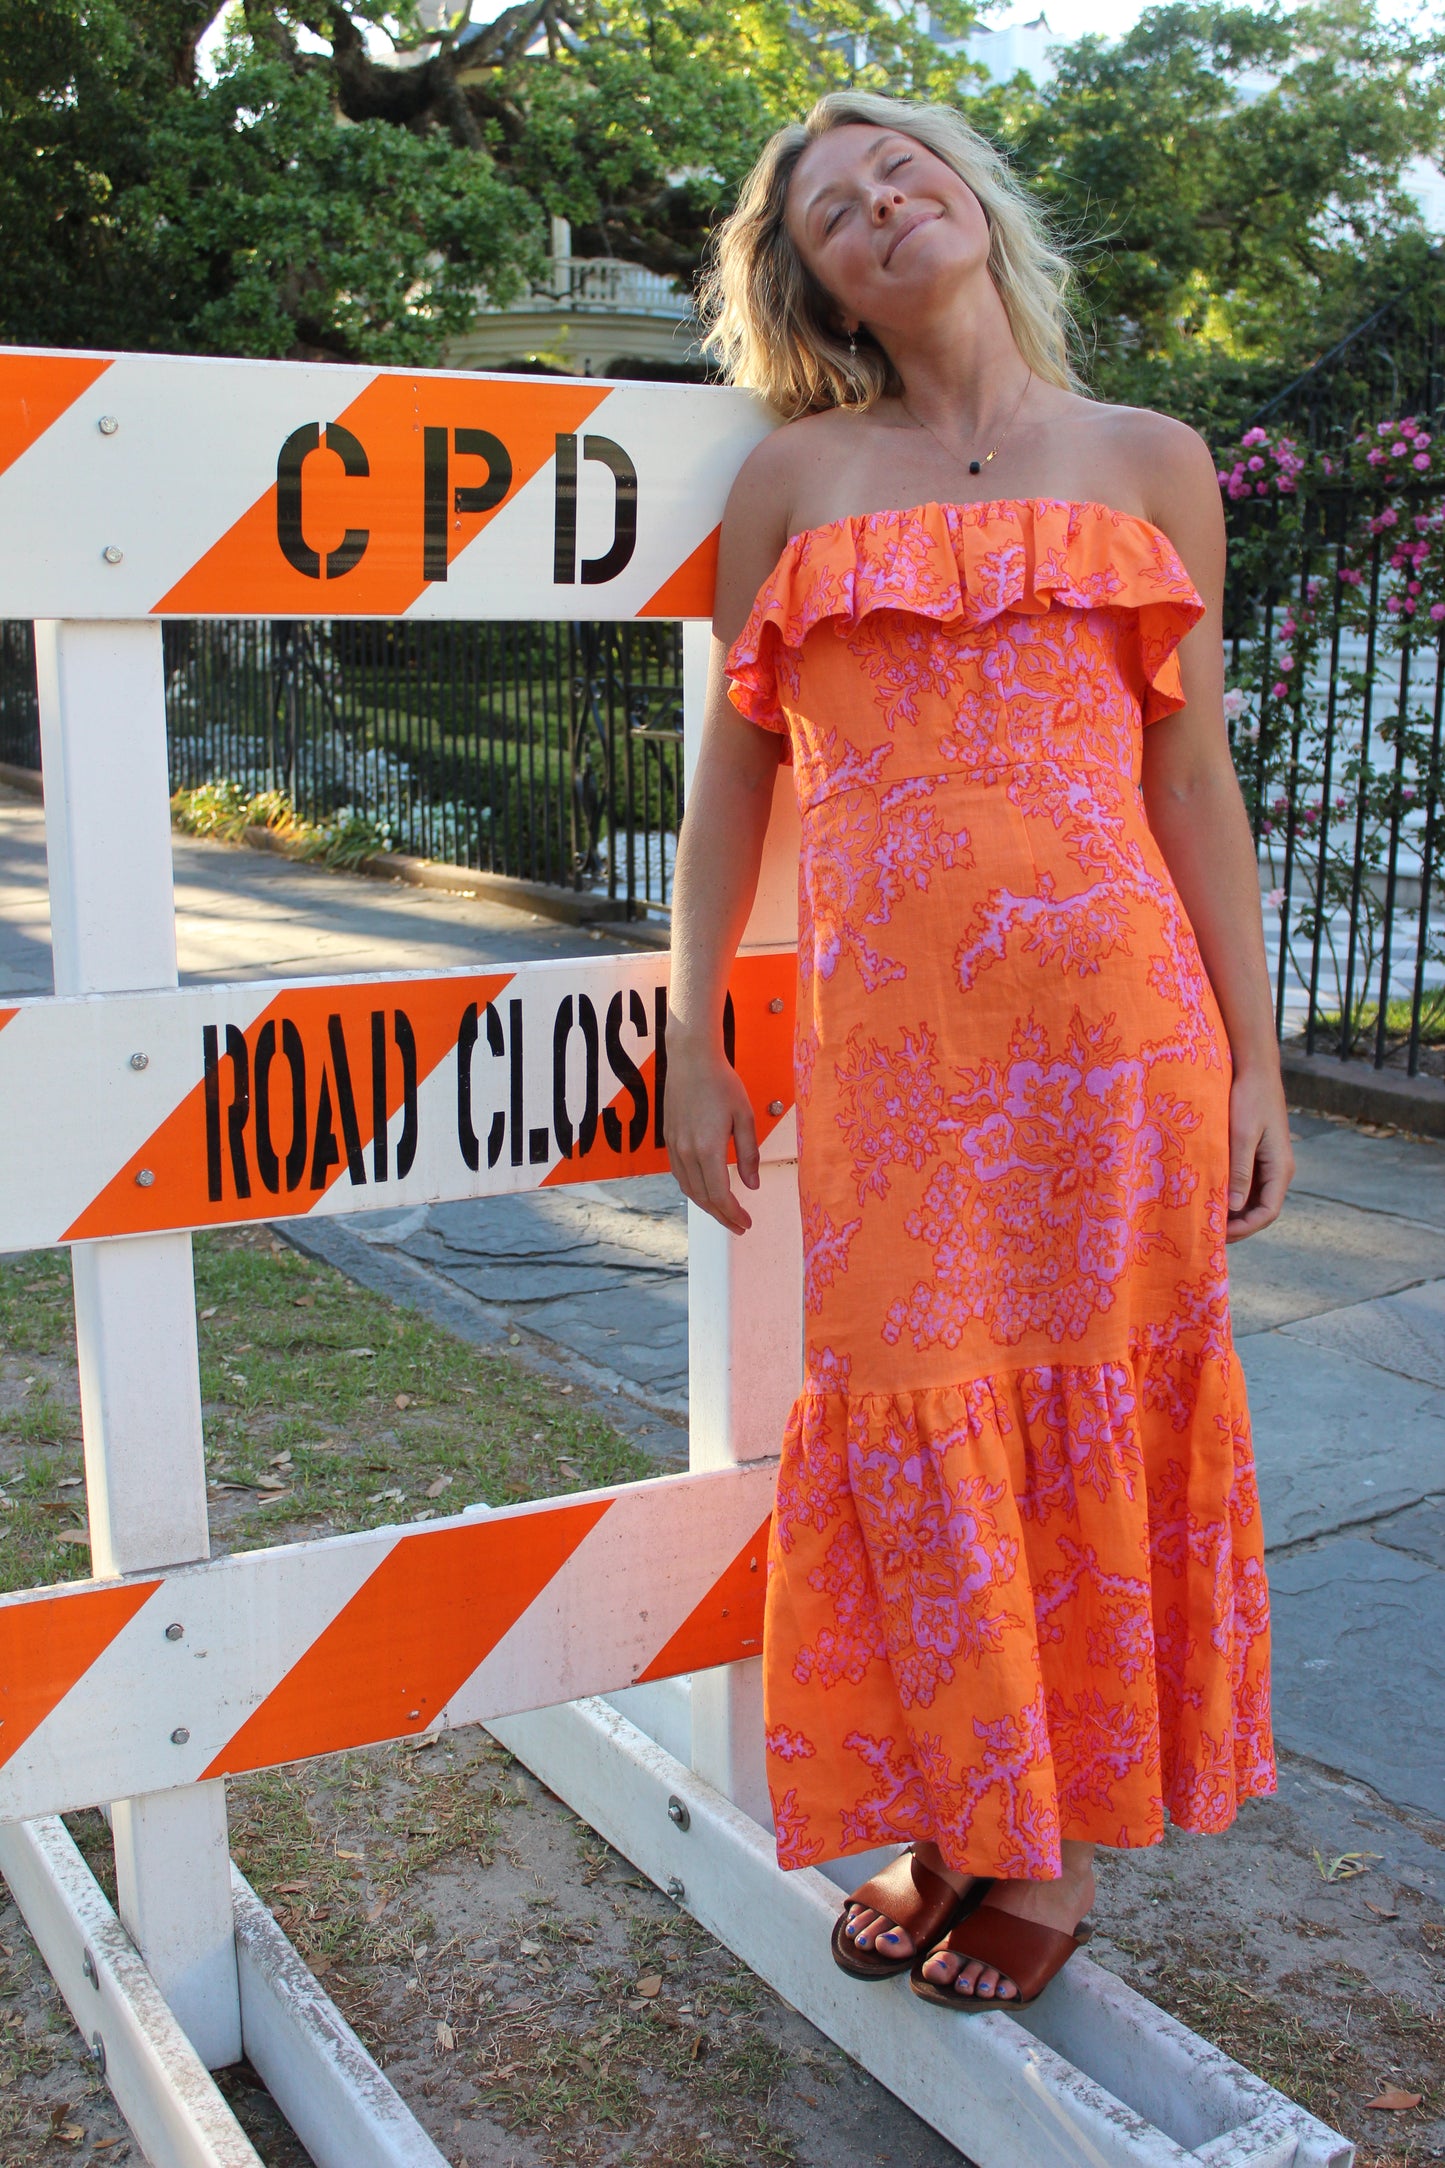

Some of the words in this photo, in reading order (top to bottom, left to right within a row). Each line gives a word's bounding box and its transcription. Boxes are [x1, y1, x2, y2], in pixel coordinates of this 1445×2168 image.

[277, 422, 637, 584] CPD
[203, 1009, 418, 1202] ROAD
[457, 986, 735, 1171] CLOS
